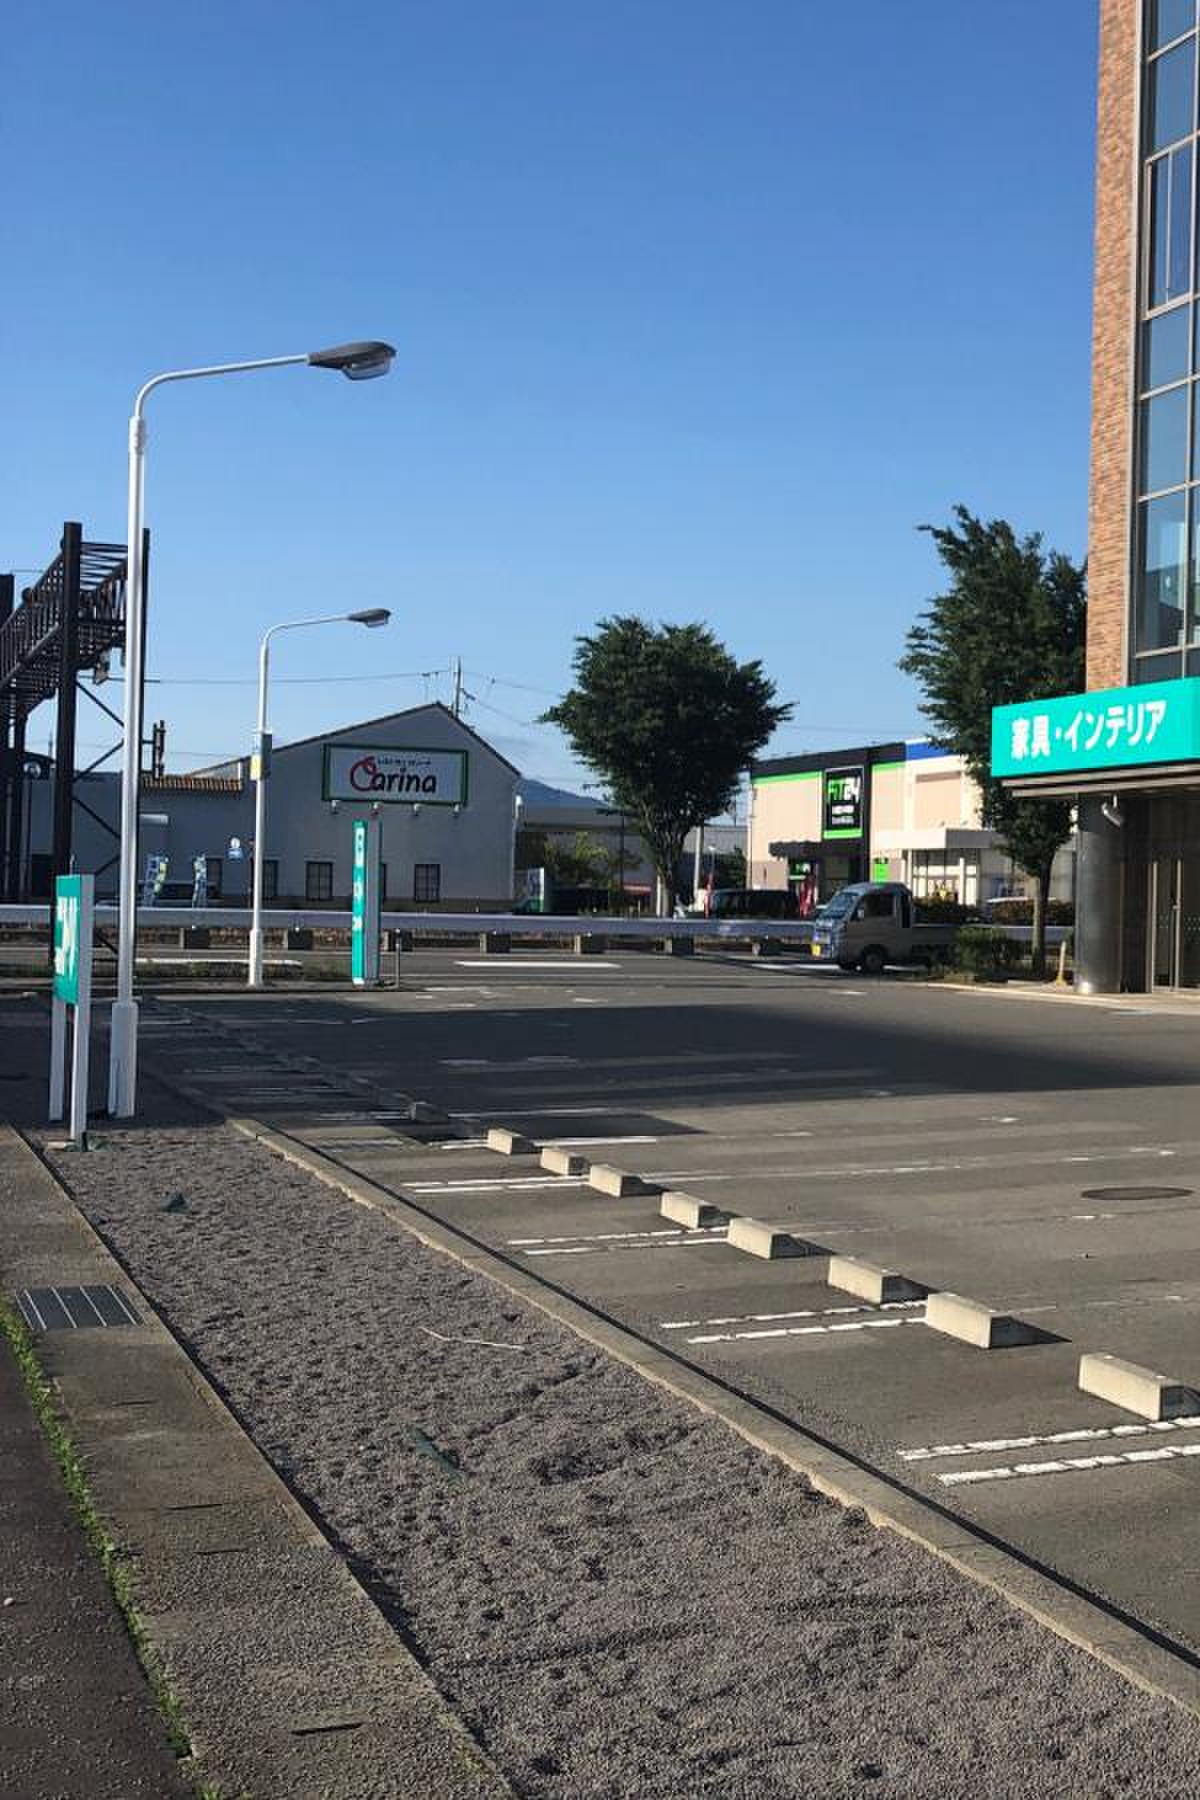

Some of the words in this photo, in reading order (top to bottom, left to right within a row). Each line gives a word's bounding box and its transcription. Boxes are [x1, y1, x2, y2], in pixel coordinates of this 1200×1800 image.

[1010, 699, 1168, 760] 家具・インテリア
[349, 755, 437, 794] Carina
